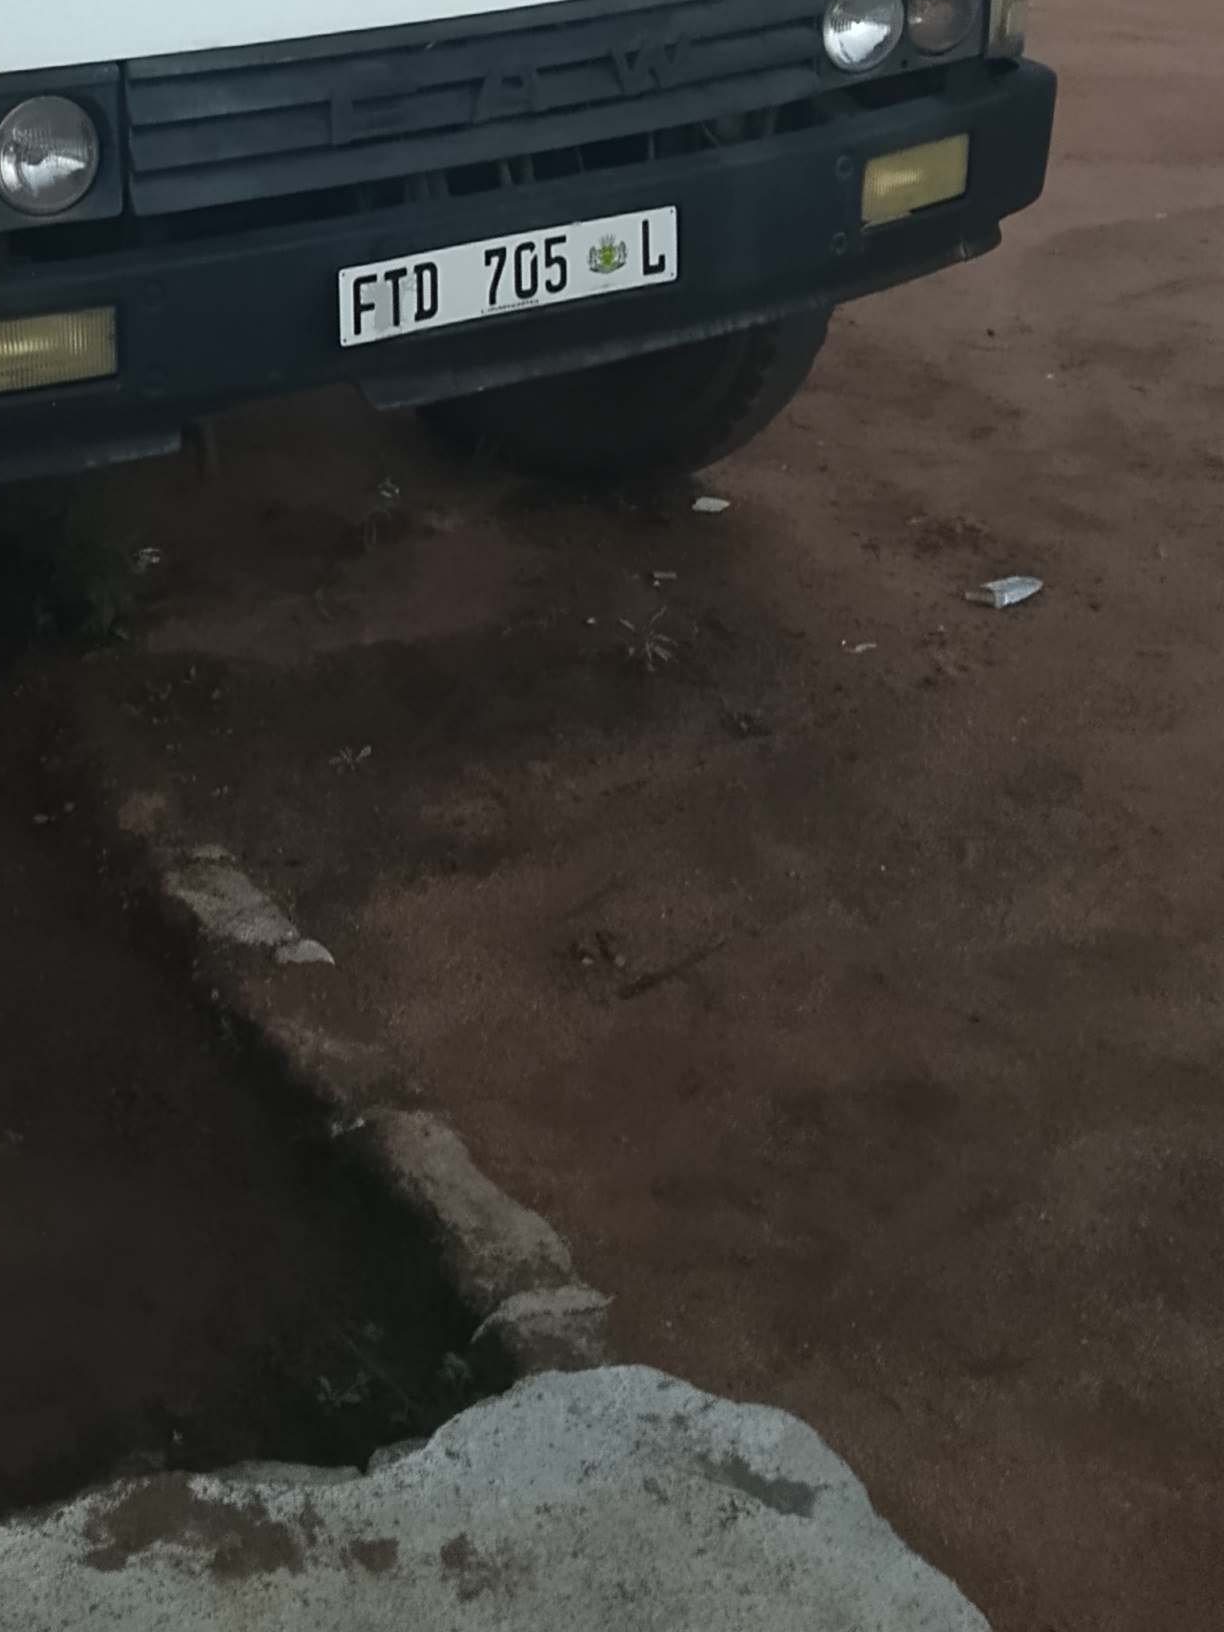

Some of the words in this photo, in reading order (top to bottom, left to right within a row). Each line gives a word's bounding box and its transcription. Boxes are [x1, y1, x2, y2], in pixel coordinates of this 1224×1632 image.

[352, 261, 439, 335] FTD
[484, 235, 568, 306] 705
[642, 219, 666, 276] L
